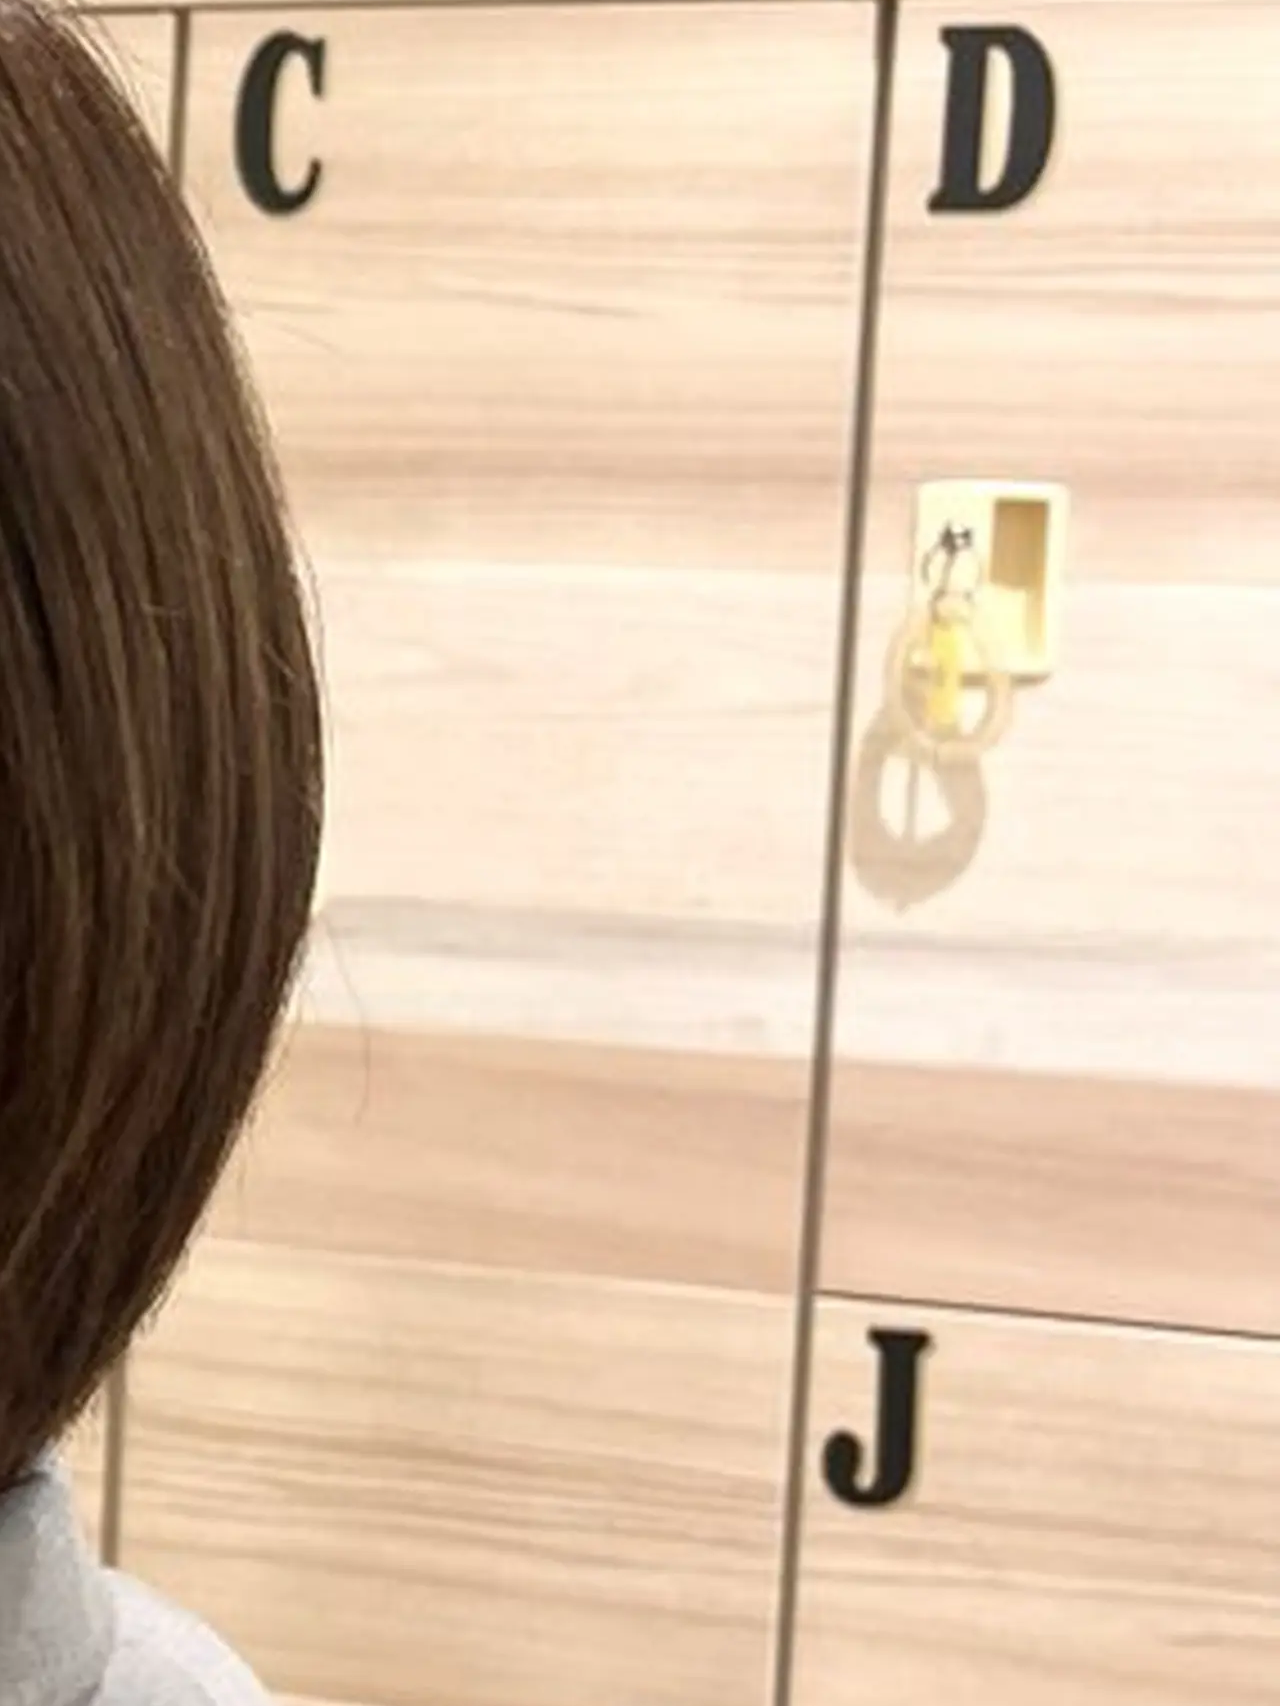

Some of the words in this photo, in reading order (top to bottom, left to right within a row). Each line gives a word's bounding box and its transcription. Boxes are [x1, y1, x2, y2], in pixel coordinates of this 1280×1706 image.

[234, 30, 325, 216] C
[927, 25, 1055, 212] D
[822, 1327, 931, 1508] J
